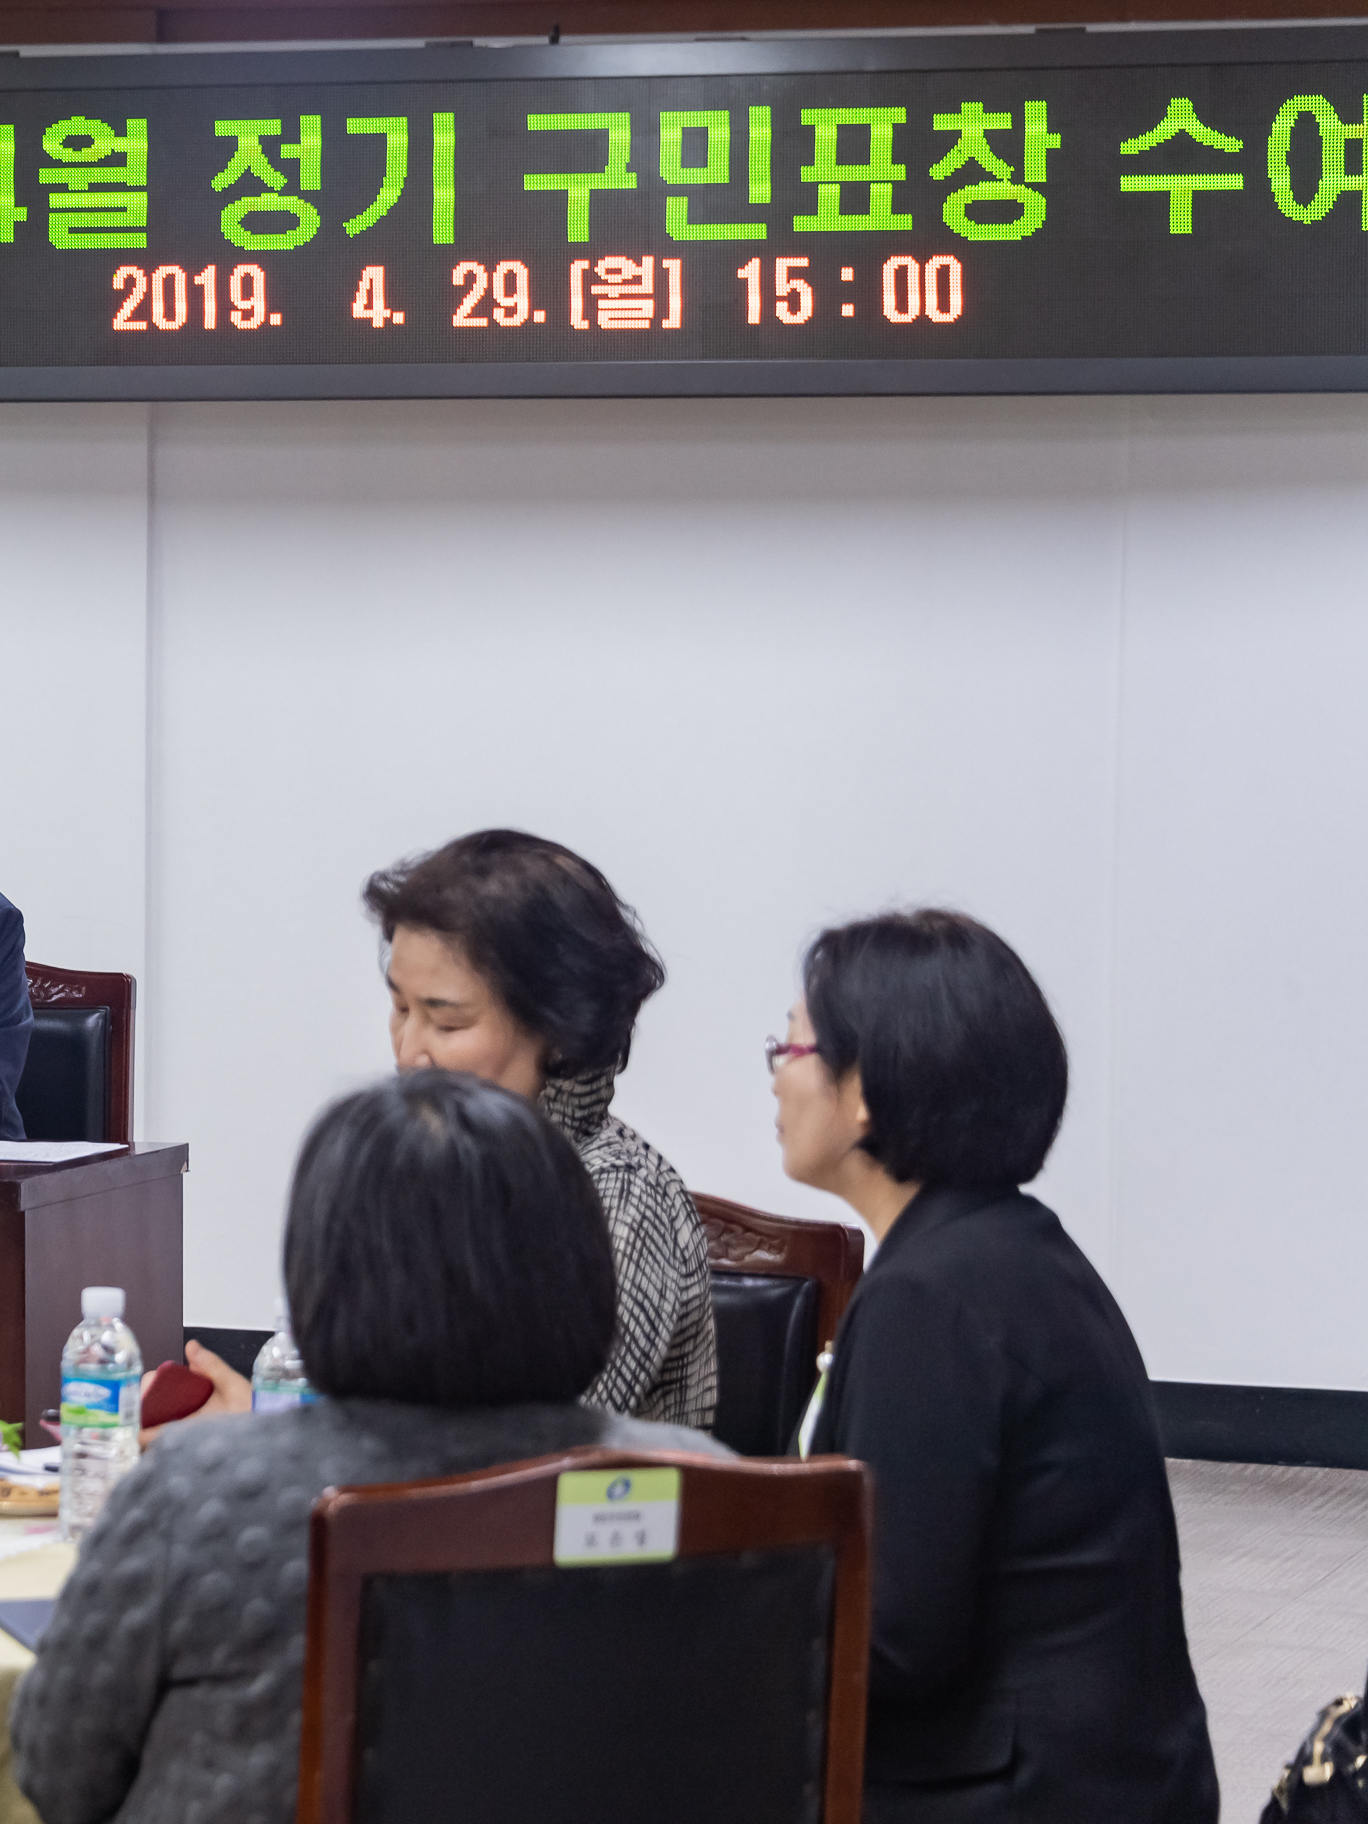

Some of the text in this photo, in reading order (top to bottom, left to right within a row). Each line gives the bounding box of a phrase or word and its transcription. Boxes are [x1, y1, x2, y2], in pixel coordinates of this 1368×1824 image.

[211, 111, 456, 250] 정기
[524, 100, 1062, 241] 구민표창
[112, 263, 283, 330] 2019.
[351, 264, 406, 328] 4.
